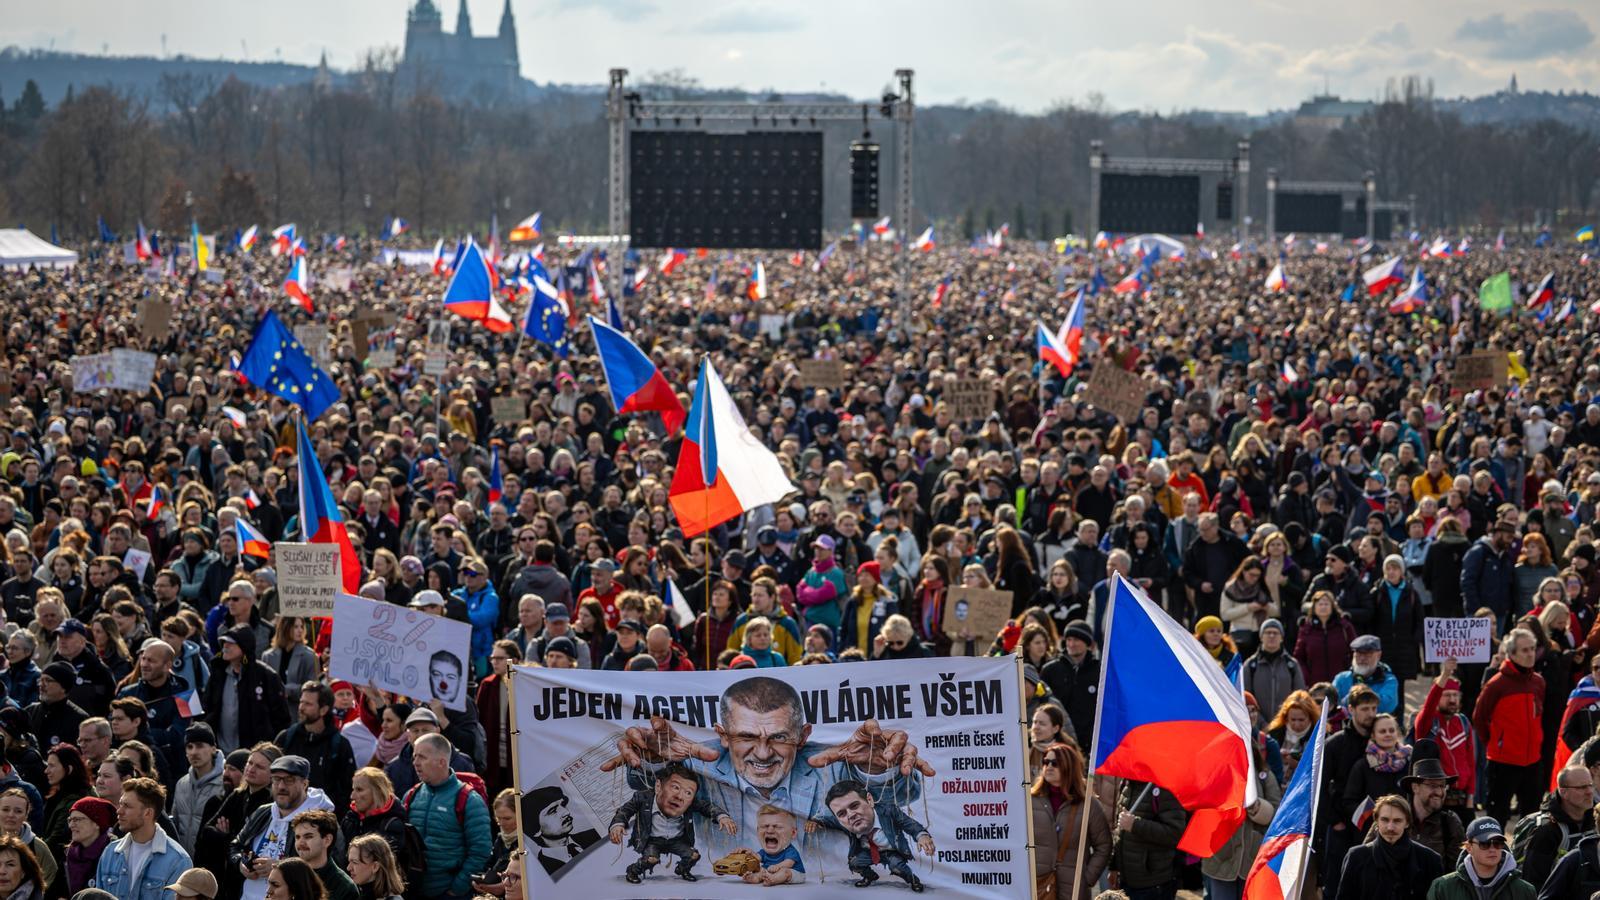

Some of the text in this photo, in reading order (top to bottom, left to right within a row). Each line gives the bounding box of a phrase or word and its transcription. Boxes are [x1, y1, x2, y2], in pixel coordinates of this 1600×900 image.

[368, 604, 435, 652] 2%
[1446, 620, 1468, 629] BYLO
[344, 637, 404, 664] JSOU
[1436, 647, 1475, 657] HRANIC
[533, 672, 1003, 728] JEDEN AGENT VLÁDNE VŠEM
[925, 731, 1005, 748] PREMIÉR ČESKÉ
[952, 756, 1006, 771] REPUBLIKY
[942, 777, 1007, 794] OBŽALOVANÝ
[963, 801, 1008, 817] SOUZENÝ
[955, 823, 1010, 840] CHRÁNĚNÝ
[938, 850, 1011, 863] POSLANECKOU
[962, 872, 1012, 885] IMUNITOU
